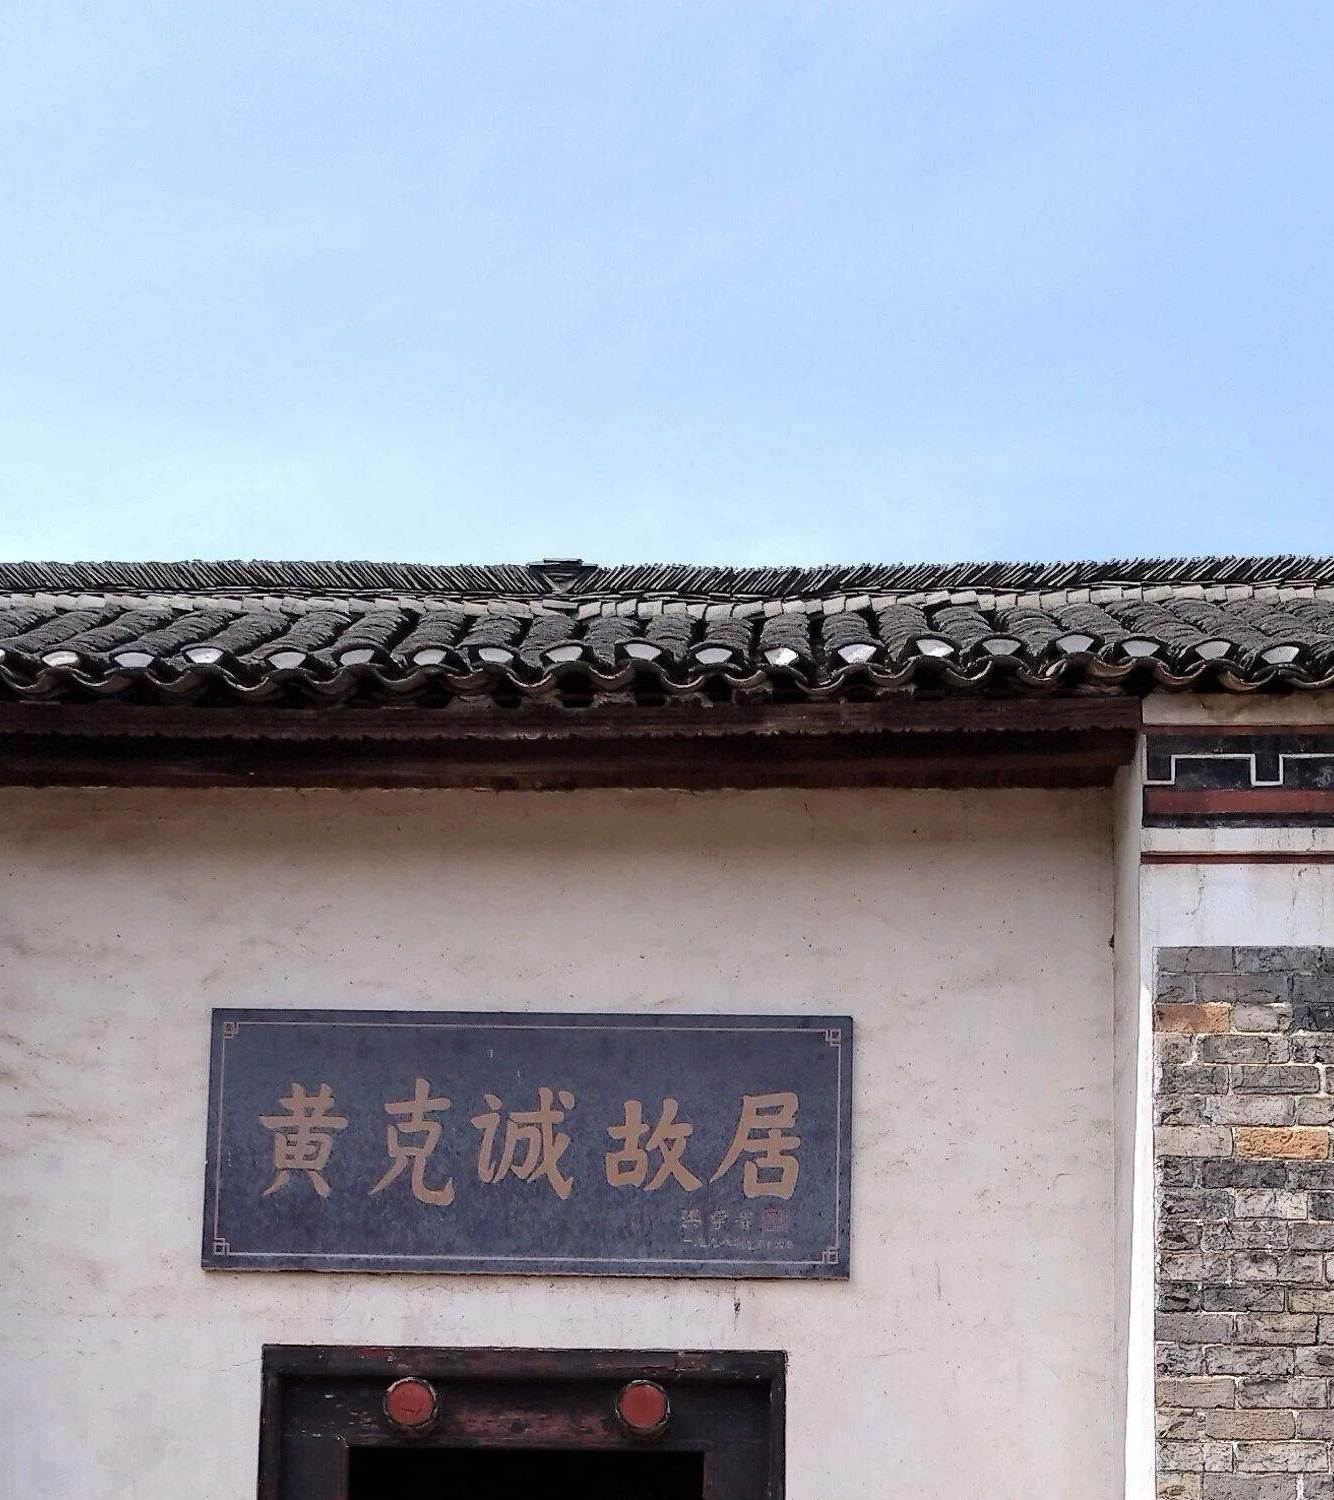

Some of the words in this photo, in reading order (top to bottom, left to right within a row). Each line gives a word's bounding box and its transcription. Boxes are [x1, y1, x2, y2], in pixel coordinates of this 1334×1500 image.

[259, 1077, 801, 1206] 黄克诚故居
